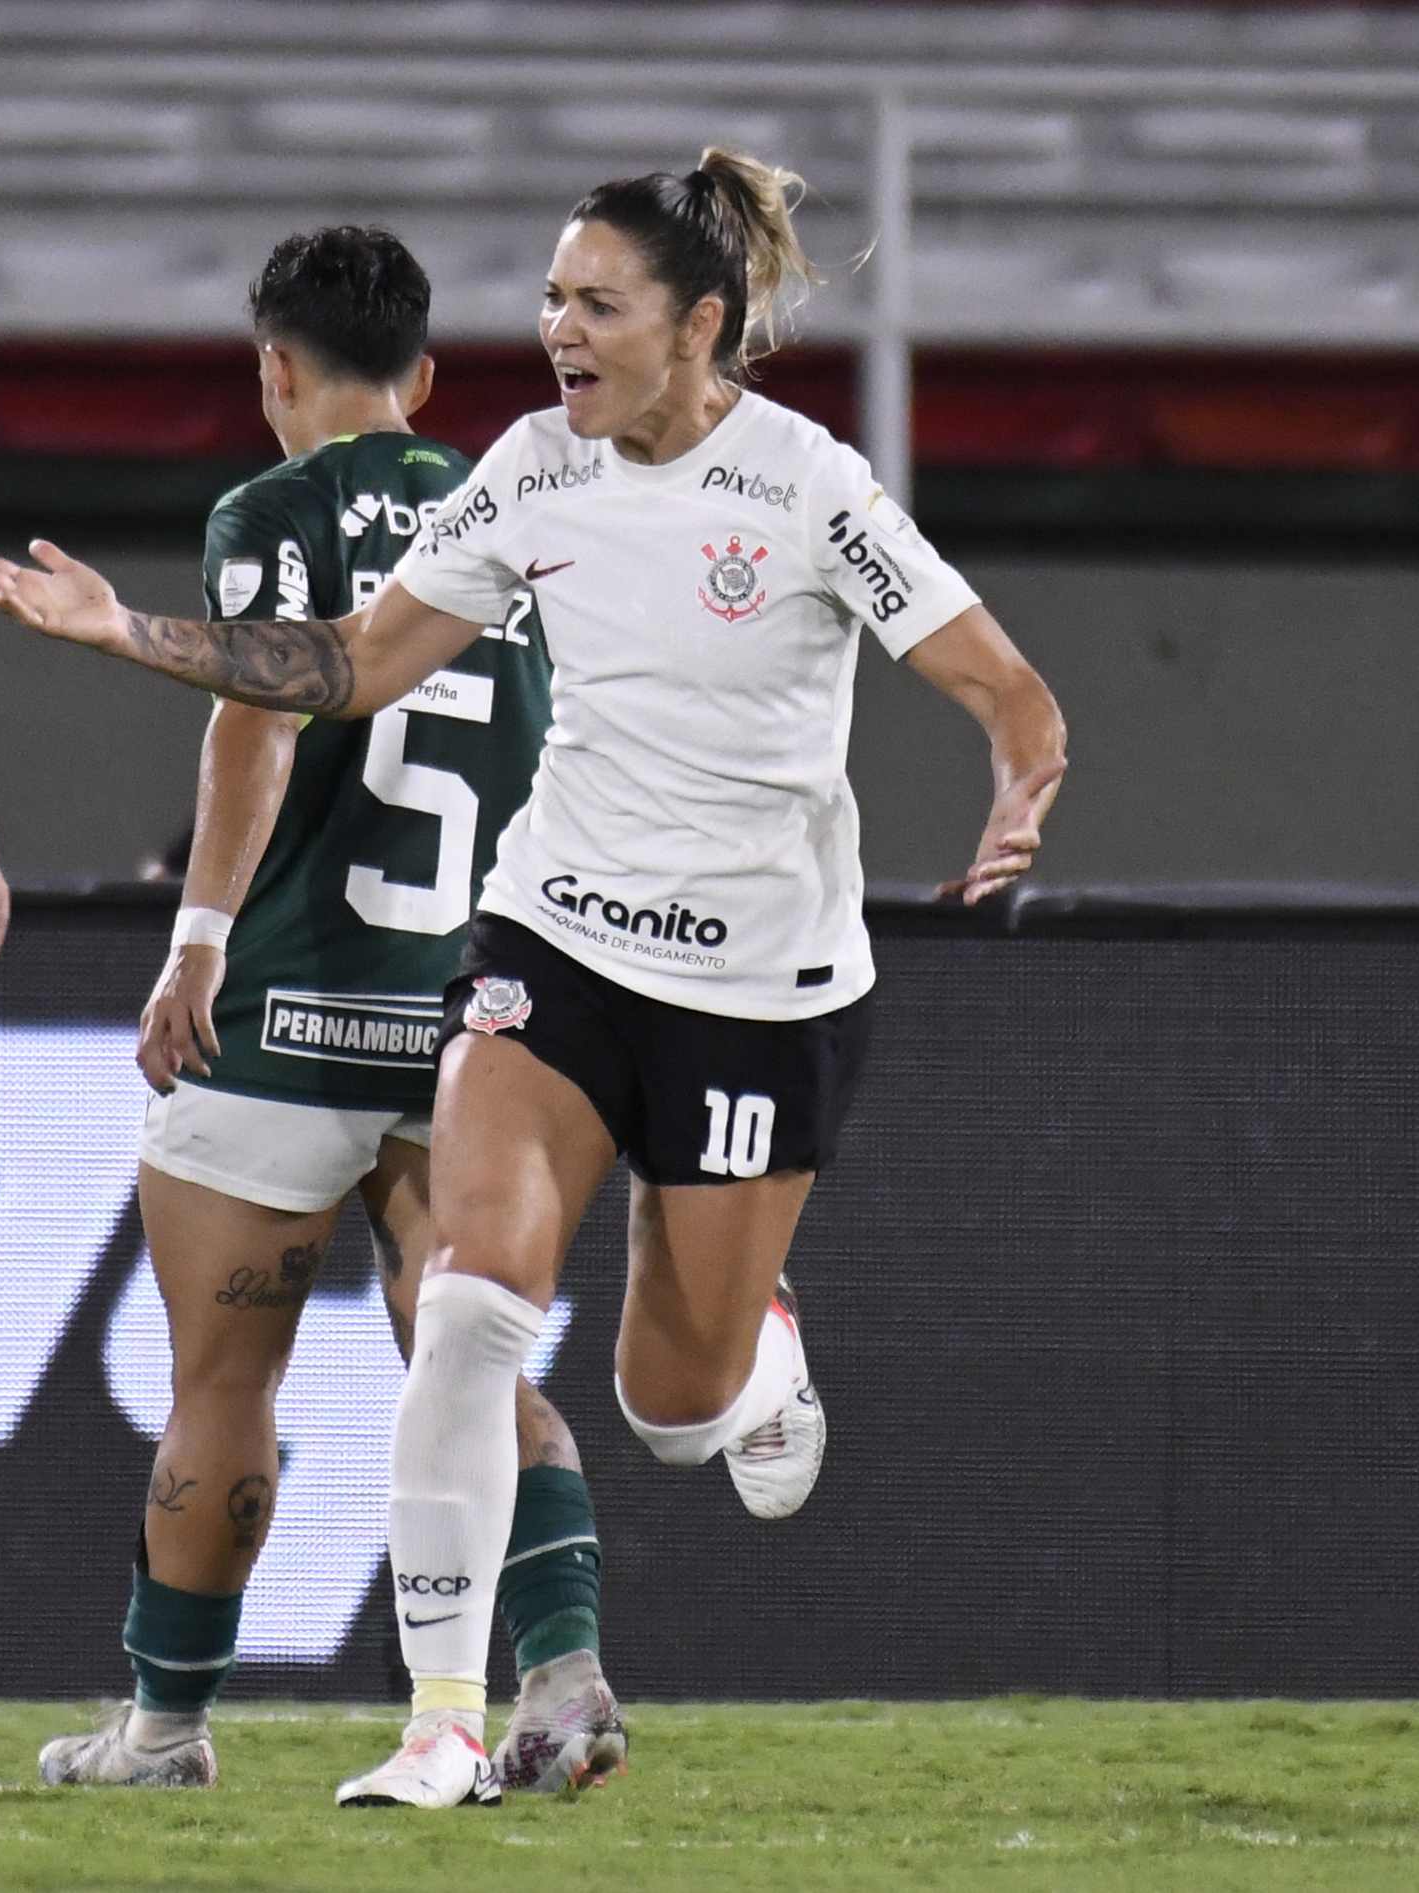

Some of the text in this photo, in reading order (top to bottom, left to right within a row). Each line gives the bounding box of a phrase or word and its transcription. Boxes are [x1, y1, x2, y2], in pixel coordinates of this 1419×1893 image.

[517, 458, 605, 502] pixbet
[700, 465, 799, 513] pixbet
[275, 540, 308, 622] MED
[839, 530, 909, 623] bmg
[412, 682, 457, 702] refisa
[345, 668, 494, 937] 5
[541, 874, 728, 948] Granito
[610, 936, 632, 951] DE
[633, 943, 726, 970] PAGAMENTO
[699, 1088, 776, 1179] 10
[397, 1572, 472, 1597] SCCP
